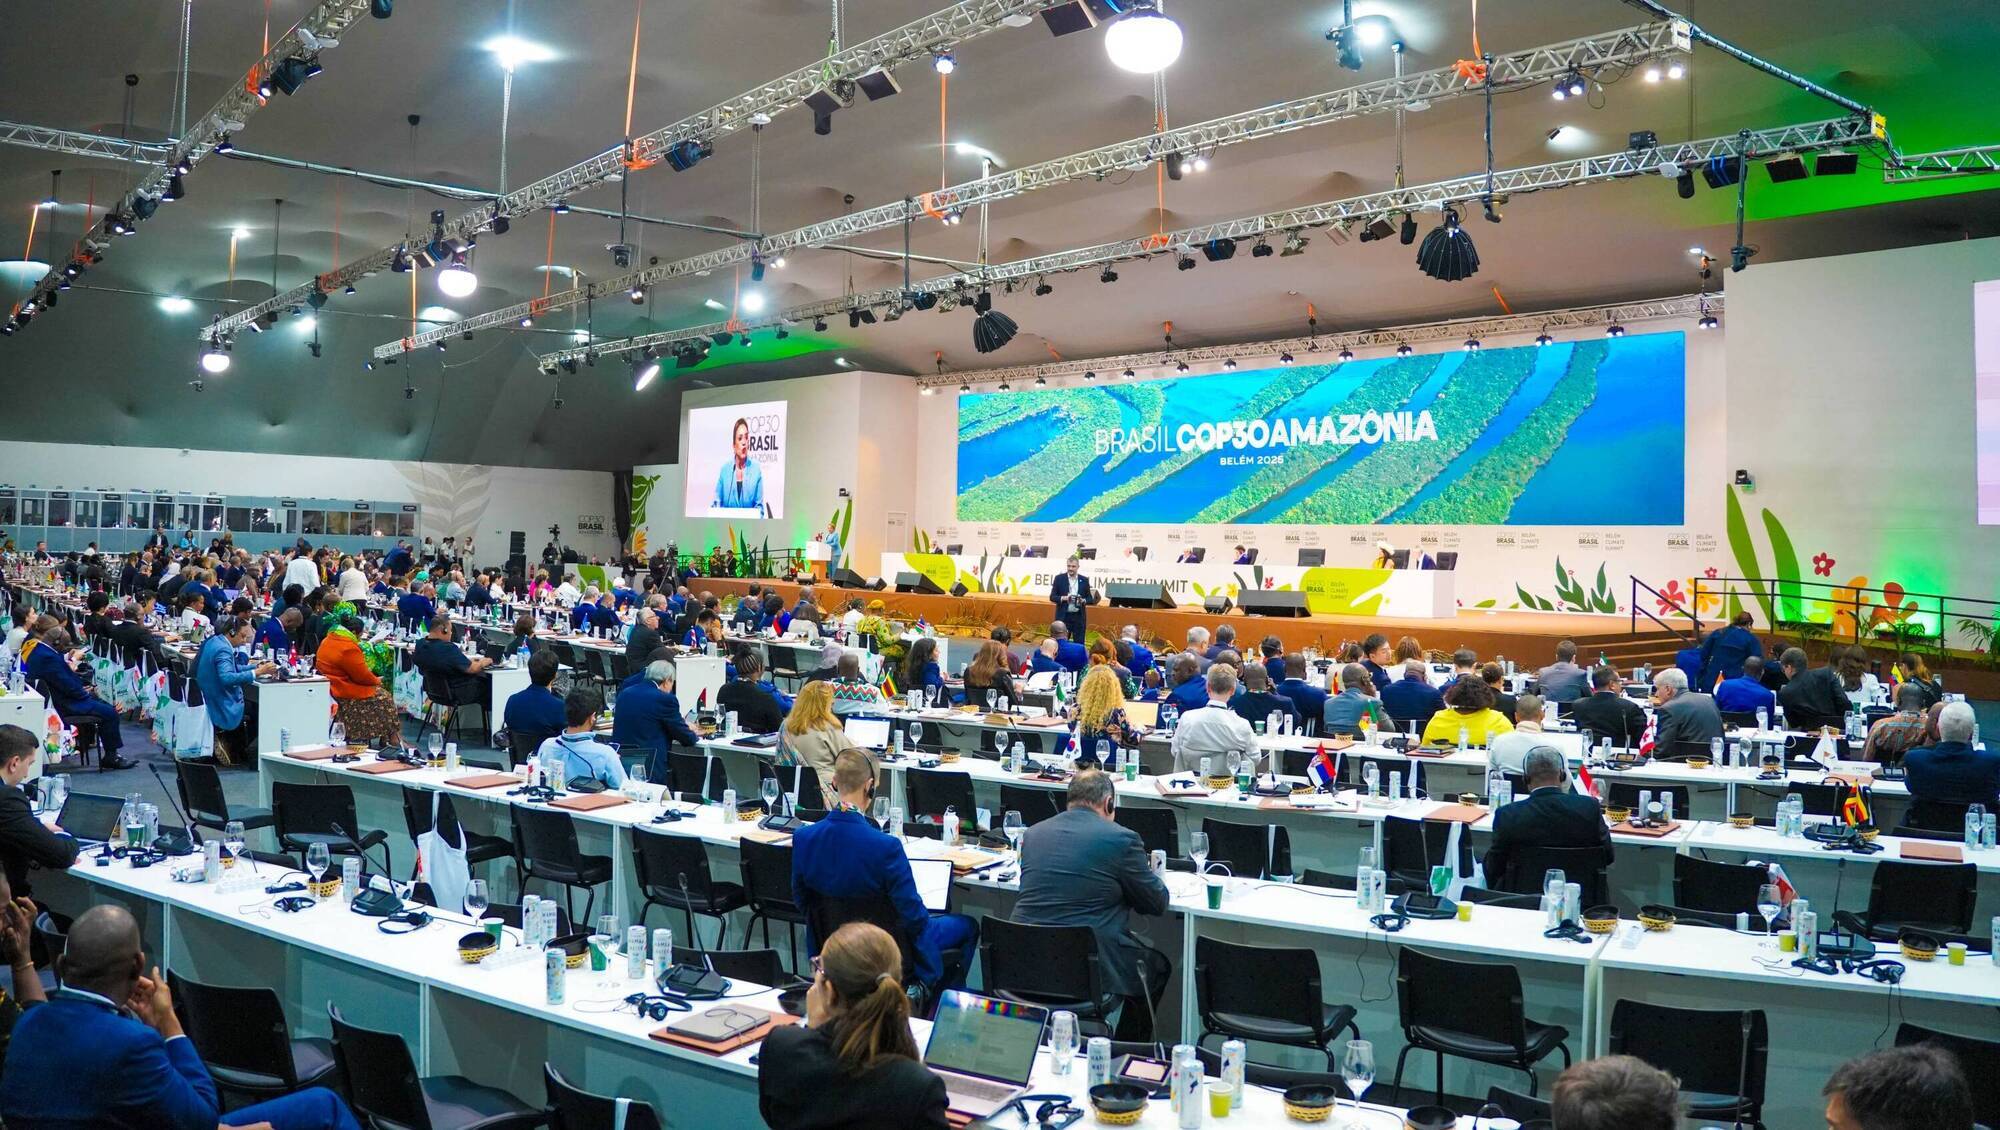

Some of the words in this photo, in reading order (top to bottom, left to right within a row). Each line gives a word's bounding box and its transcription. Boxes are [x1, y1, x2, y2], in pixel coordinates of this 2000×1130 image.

[747, 414, 780, 434] OP30
[1219, 456, 1254, 466] BELÉM
[578, 522, 604, 530] BRASIL
[1035, 574, 1055, 586] BEL
